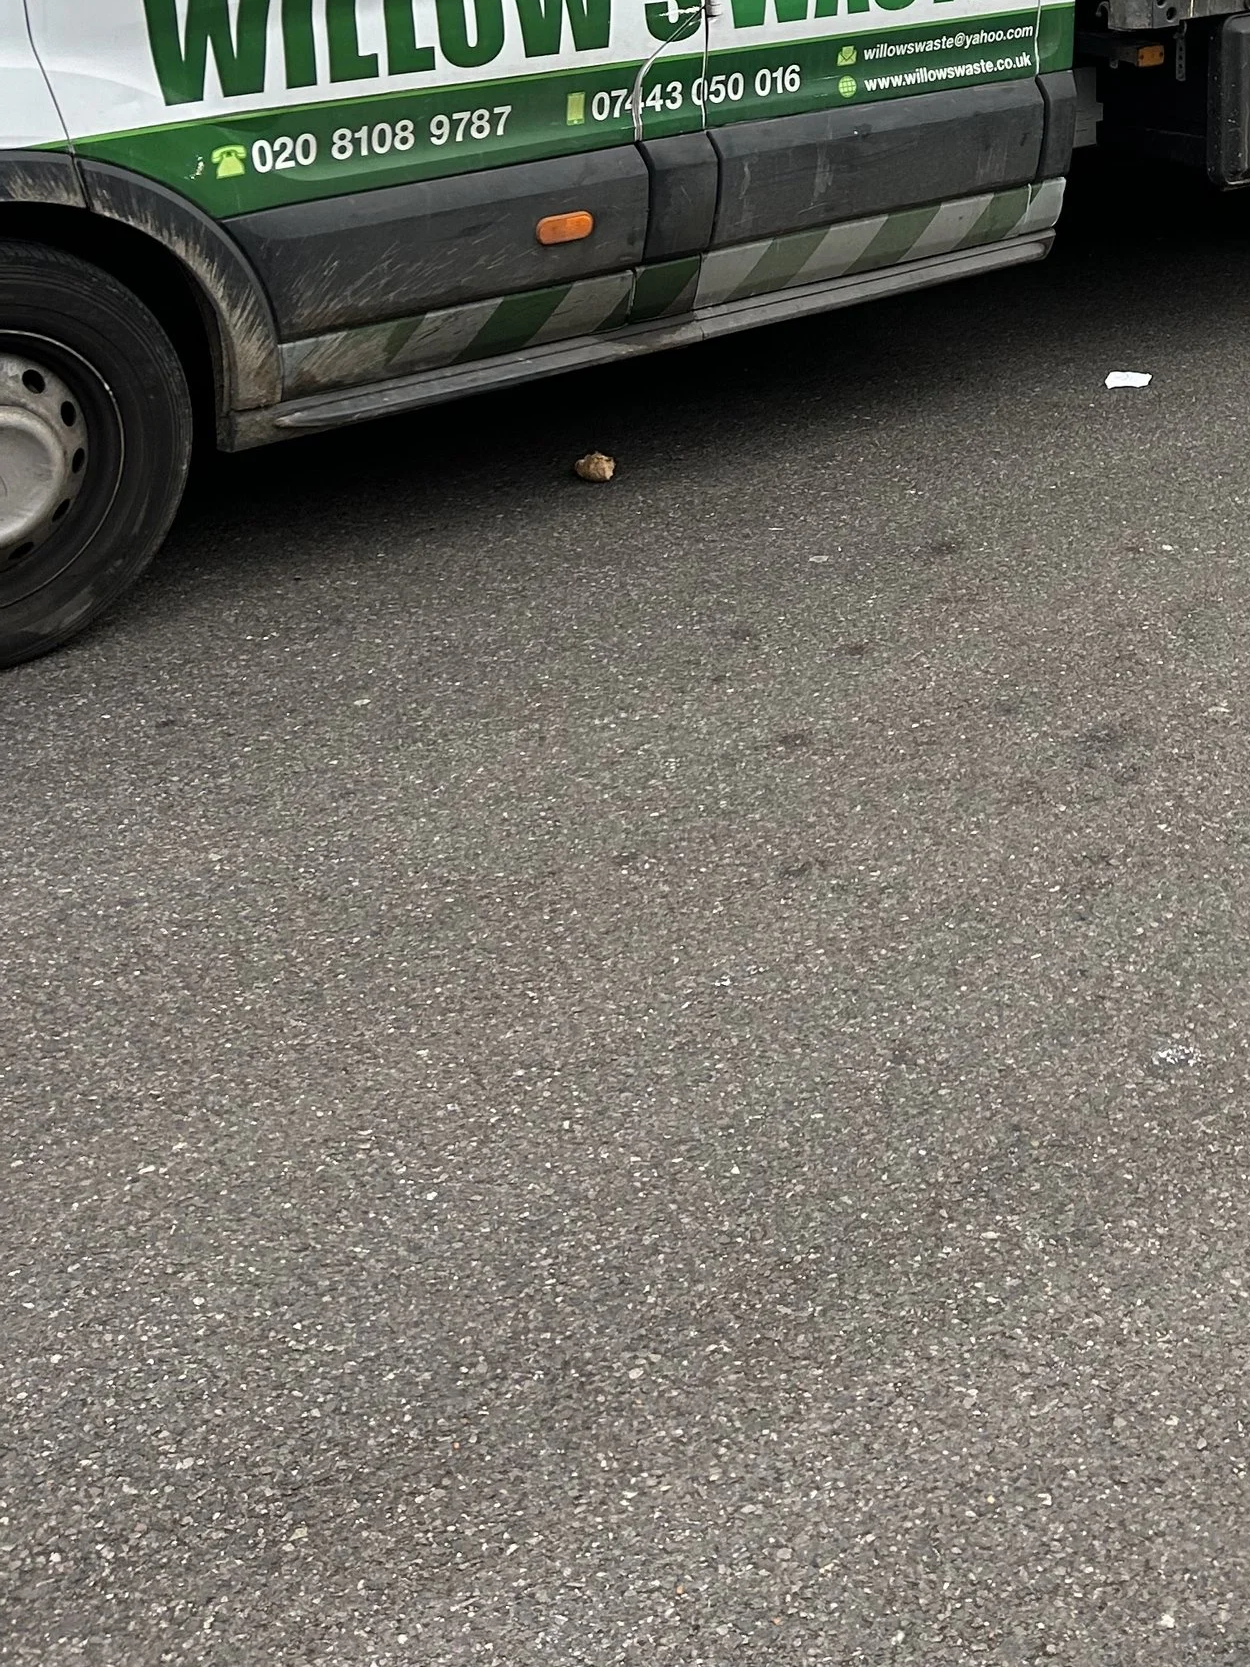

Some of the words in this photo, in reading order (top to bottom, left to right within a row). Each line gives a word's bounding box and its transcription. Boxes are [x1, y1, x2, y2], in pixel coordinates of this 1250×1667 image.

[863, 26, 1034, 61] willowswaste@yahoo.com
[591, 81, 683, 121] 07443
[691, 72, 745, 105] 050
[754, 64, 801, 97] 016
[863, 52, 1032, 92] www.willowswaste.co.uk
[251, 133, 317, 173] 020
[331, 119, 415, 160] 8108
[429, 105, 512, 145] 9787
